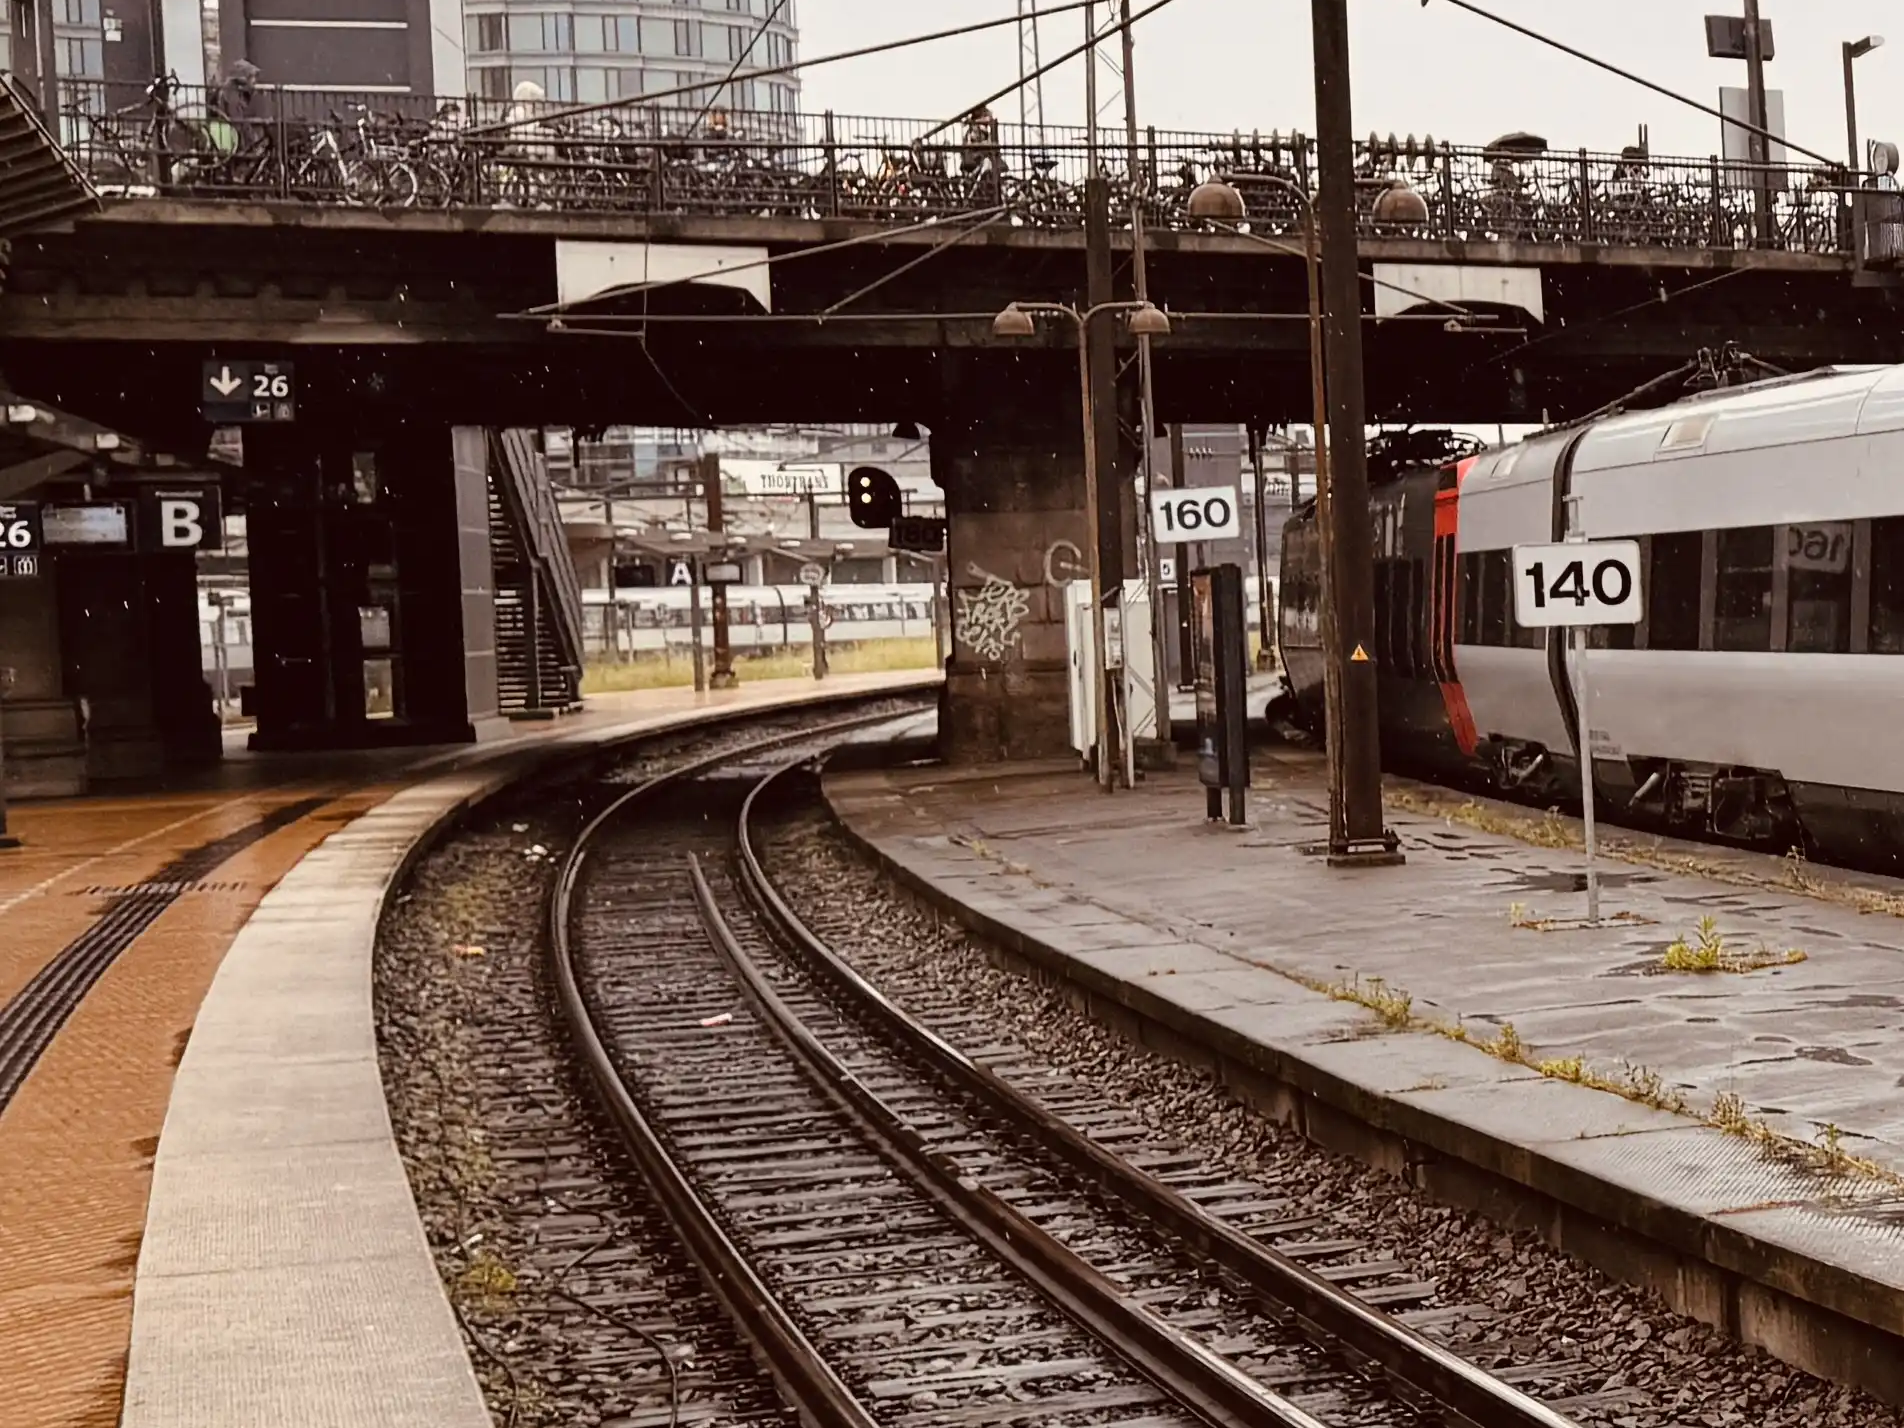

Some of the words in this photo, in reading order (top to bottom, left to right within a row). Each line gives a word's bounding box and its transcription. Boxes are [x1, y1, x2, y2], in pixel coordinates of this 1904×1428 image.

[253, 375, 289, 398] 26
[161, 501, 203, 547] B
[1160, 497, 1231, 531] 160
[671, 561, 693, 586] A
[1525, 559, 1632, 608] 140
